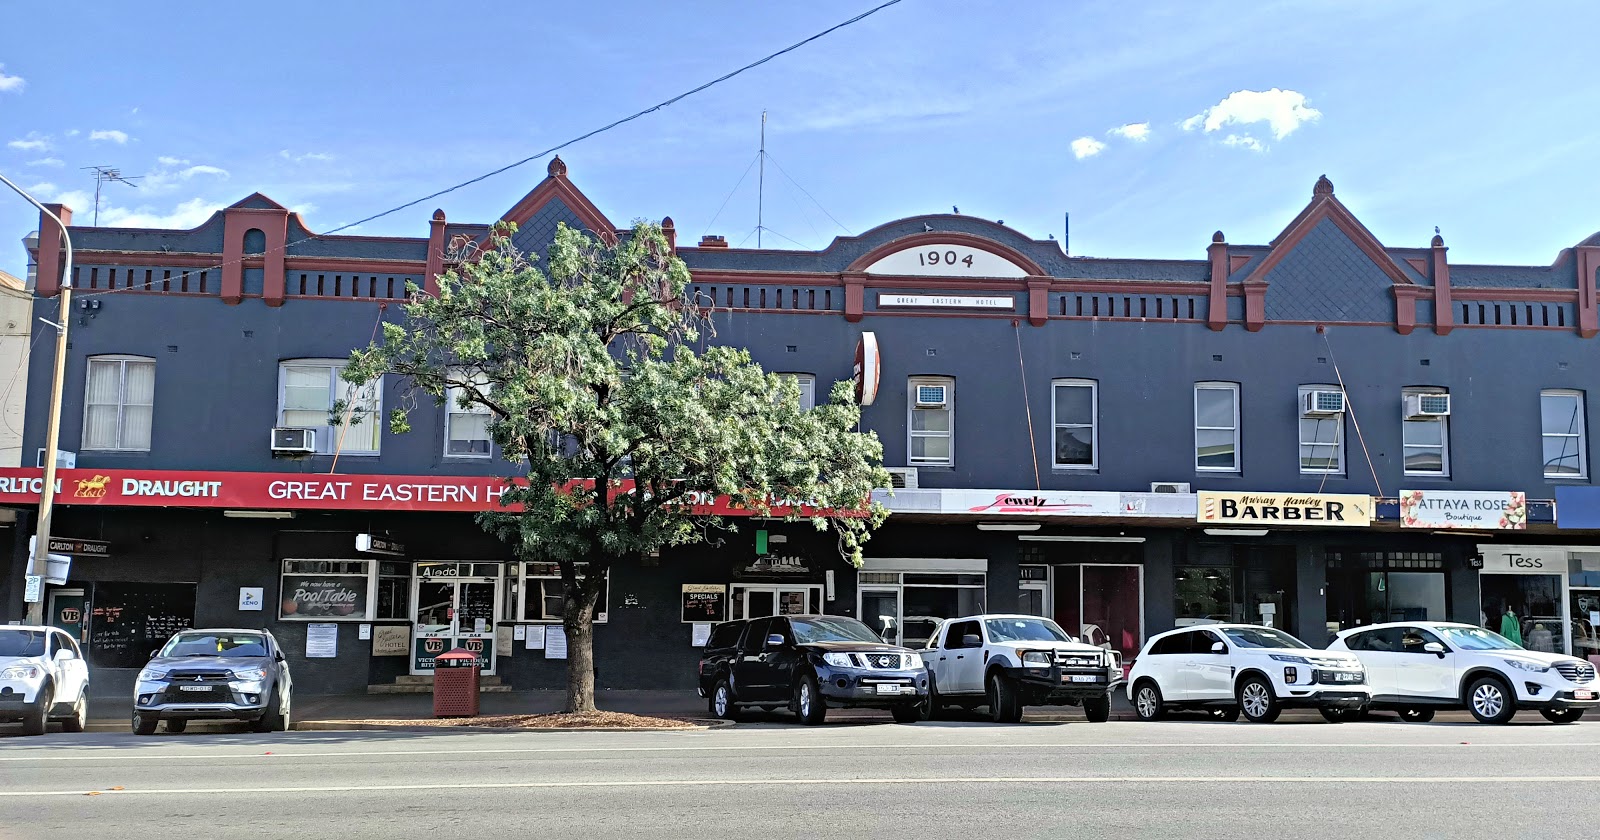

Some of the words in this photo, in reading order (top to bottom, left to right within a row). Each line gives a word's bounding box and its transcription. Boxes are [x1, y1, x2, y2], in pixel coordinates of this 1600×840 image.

[919, 251, 973, 268] 1904
[121, 478, 222, 497] DRAUGHT
[268, 480, 352, 500] GREAT
[362, 483, 477, 503] EASTERN
[968, 493, 1048, 512] Jewelz
[1239, 496, 1276, 506] Murray
[1283, 497, 1322, 507] Hanley
[1418, 499, 1470, 511] ATTAYA
[1474, 500, 1507, 511] ROSE
[1220, 498, 1345, 521] BARBER
[1445, 512, 1483, 522] Boutique
[49, 541, 74, 550] CARLTON
[83, 543, 108, 553] DRAUGHT
[1469, 558, 1482, 567] Tess
[1502, 553, 1543, 568] Tess
[293, 589, 324, 601] Pool
[324, 588, 357, 602] Table
[62, 611, 78, 620] VB
[426, 642, 442, 650] VB
[467, 642, 482, 650] VB
